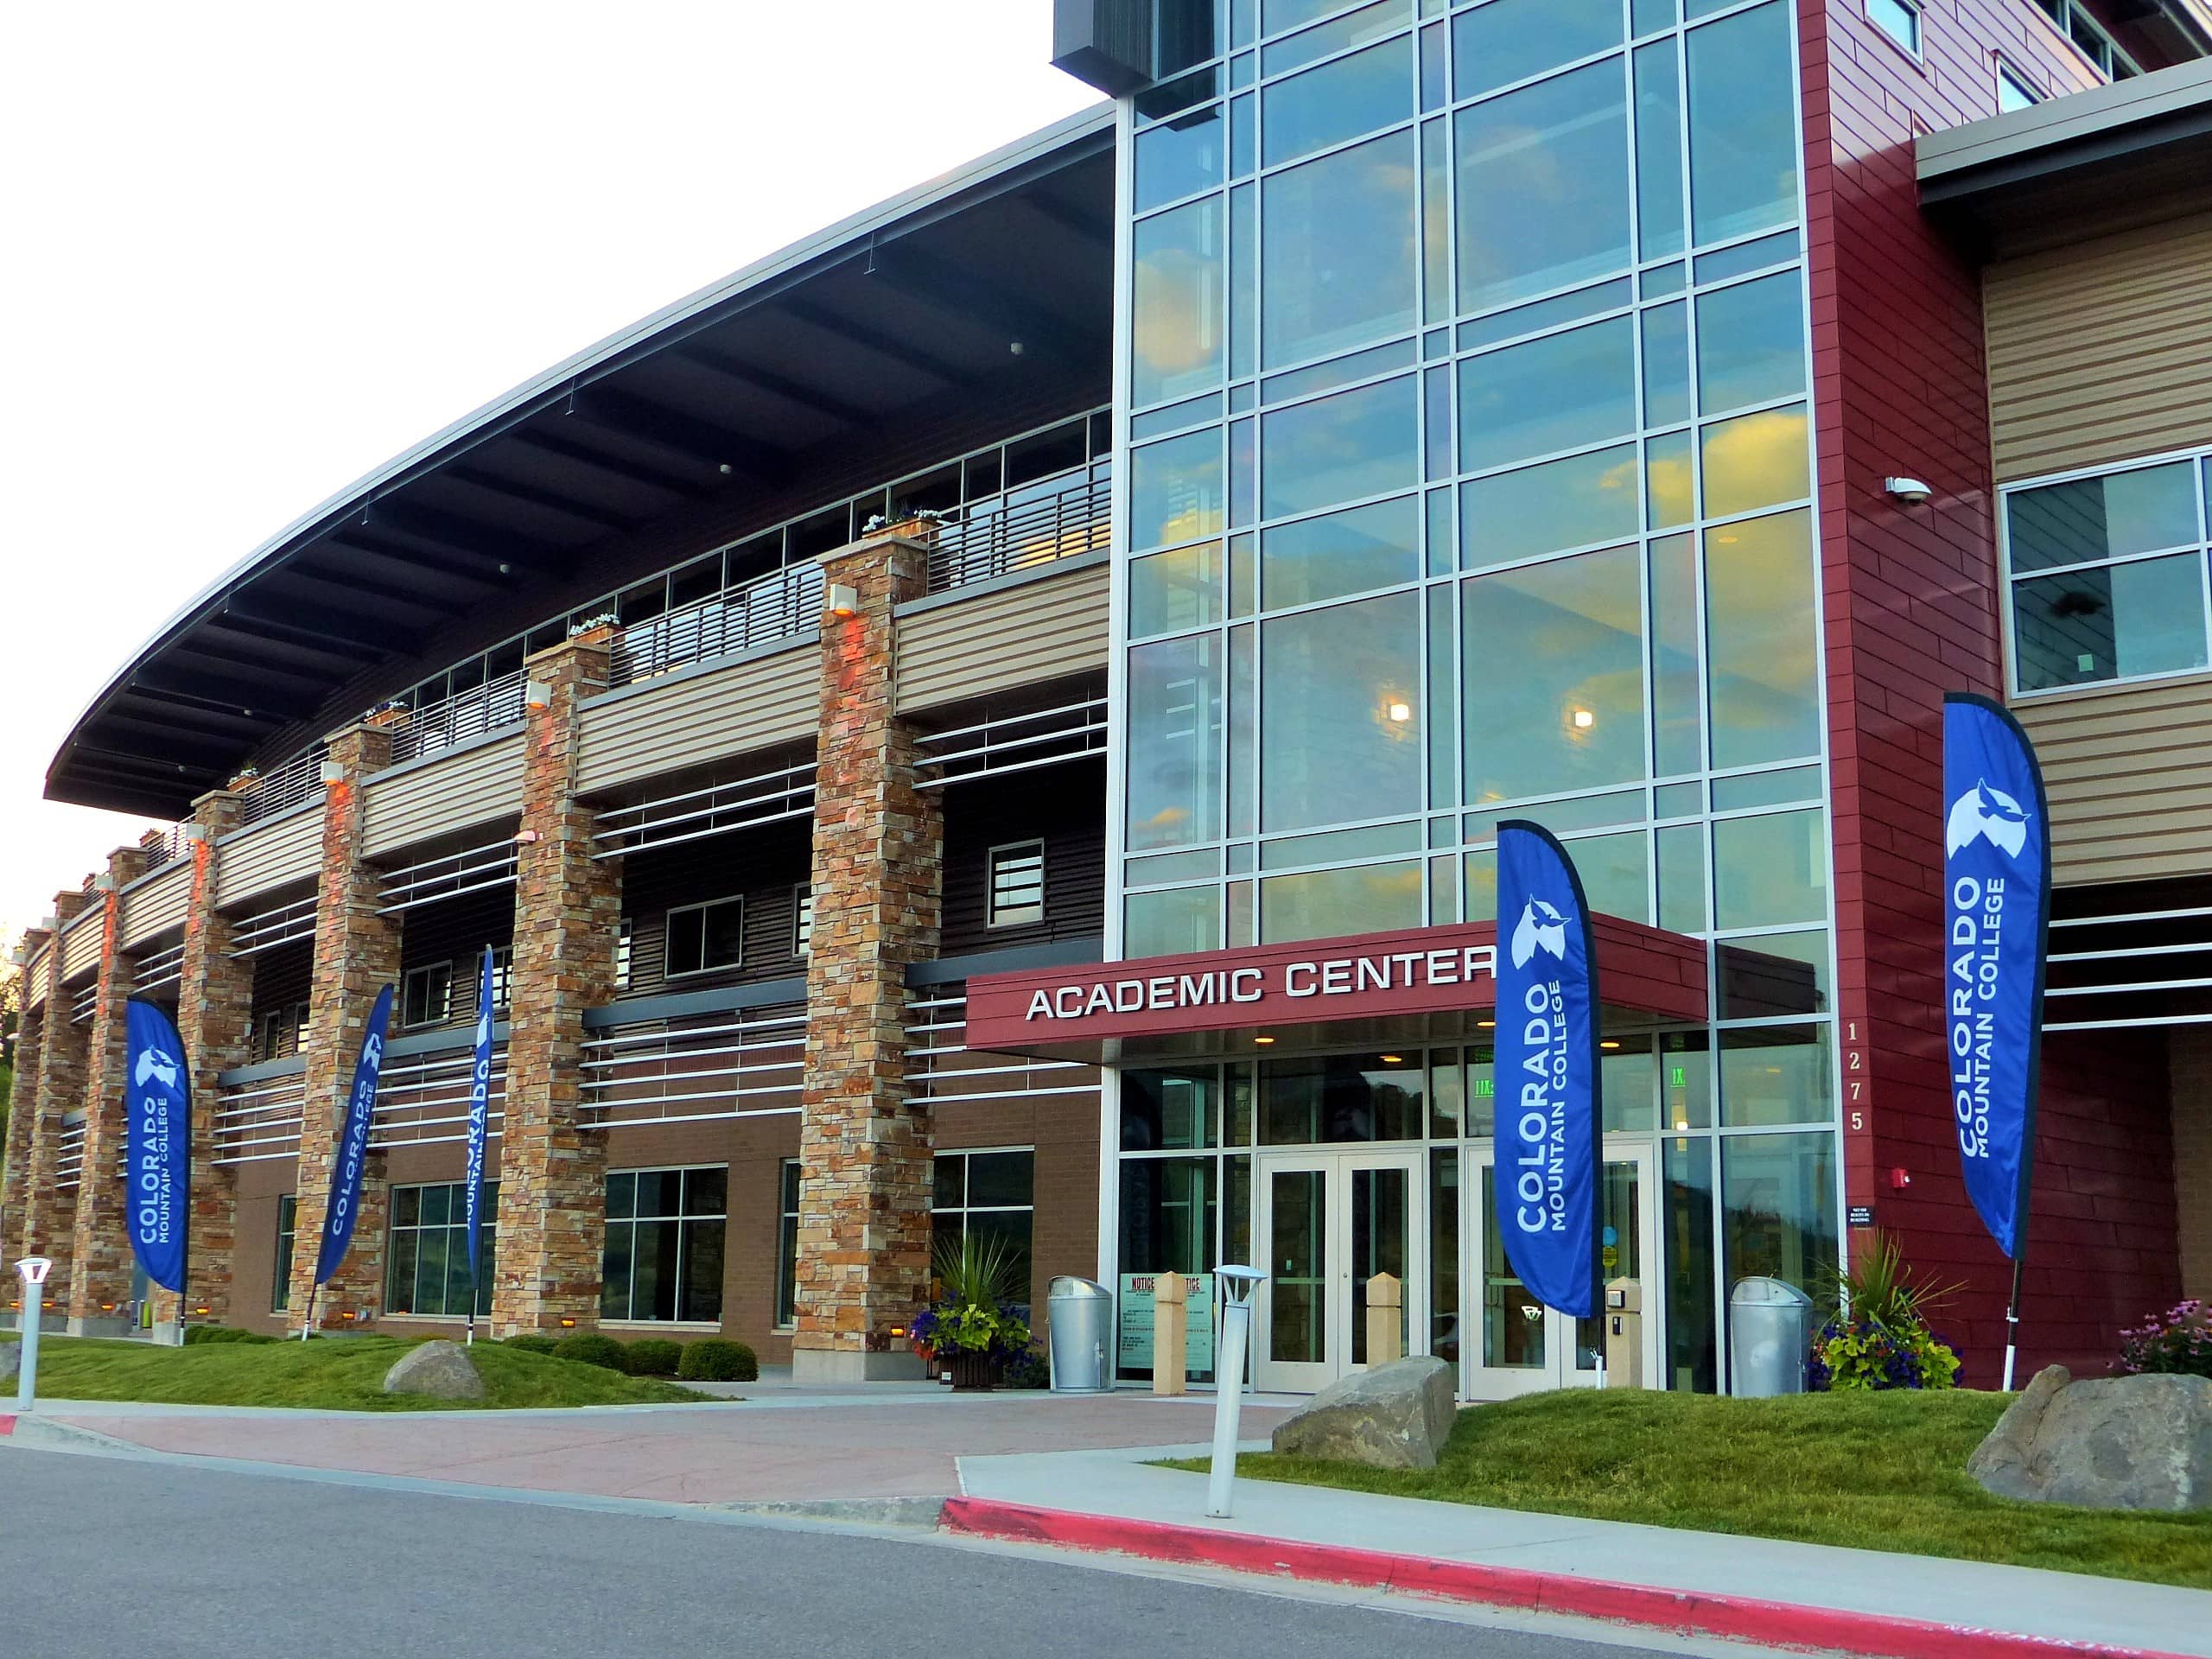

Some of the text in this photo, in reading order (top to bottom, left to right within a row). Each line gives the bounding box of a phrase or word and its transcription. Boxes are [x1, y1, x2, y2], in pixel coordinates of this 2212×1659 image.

[1025, 944, 1497, 1020] ACADEMIC CENTER
[1952, 876, 1980, 1158] COLORADO
[1974, 878, 2005, 1158] MOUNTAIN COLLEGE
[139, 1096, 161, 1244] COLORADO
[158, 1097, 171, 1243] MOUNTAIN COLLEGE
[332, 1080, 367, 1236] COLORADO
[1516, 983, 1550, 1233] COLORADO
[1548, 980, 1568, 1231] MOUNTAIN COLLEGE
[1131, 1277, 1155, 1290] NOTICE
[1185, 1278, 1200, 1291] TICE
